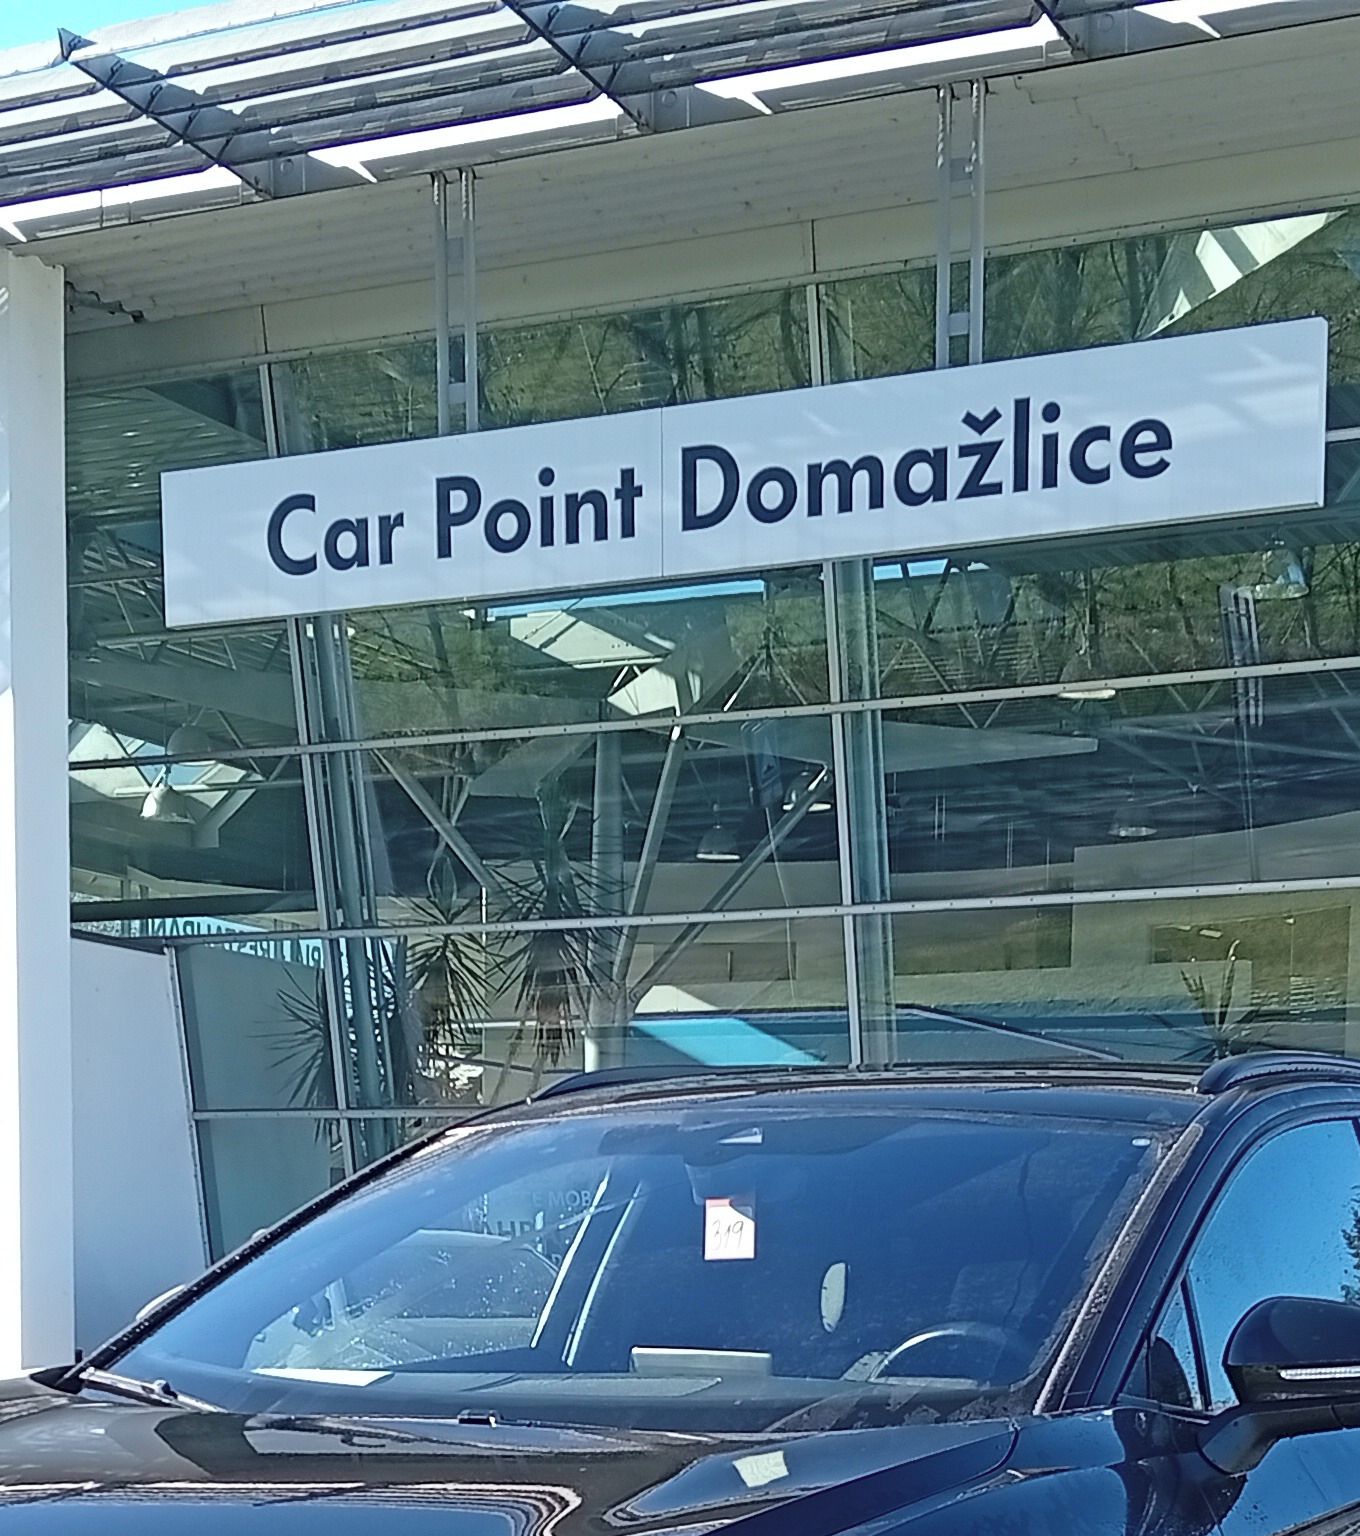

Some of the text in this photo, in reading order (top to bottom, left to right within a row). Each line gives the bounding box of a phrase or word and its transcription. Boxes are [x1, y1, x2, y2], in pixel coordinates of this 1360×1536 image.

[266, 397, 1174, 577] Car Point Domažlice
